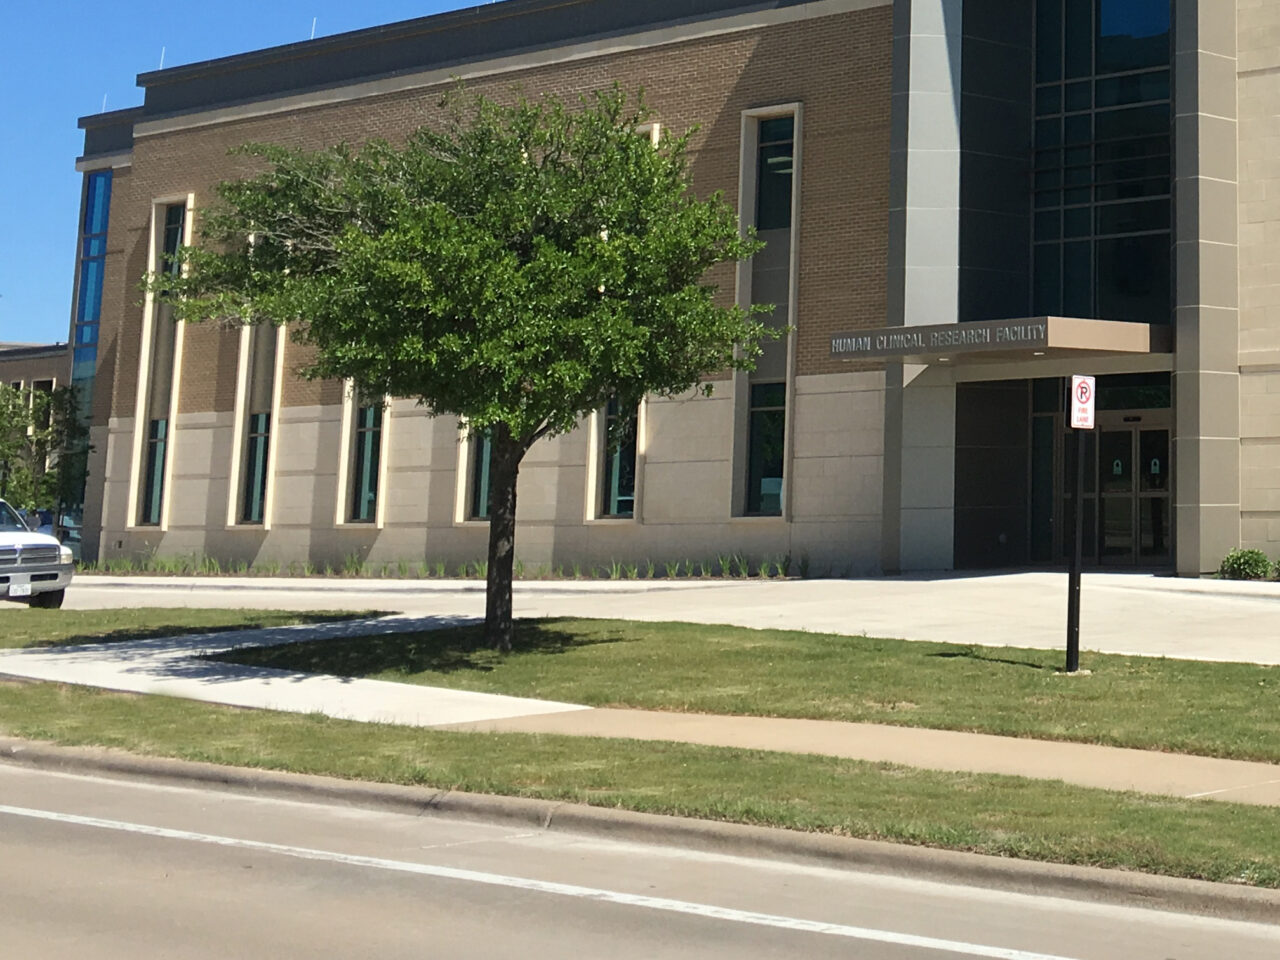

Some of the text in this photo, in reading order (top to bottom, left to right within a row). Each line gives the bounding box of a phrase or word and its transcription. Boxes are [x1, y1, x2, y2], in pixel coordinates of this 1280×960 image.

[832, 324, 1046, 353] HUMAN CLINICAL RESEARCH FACILITY
